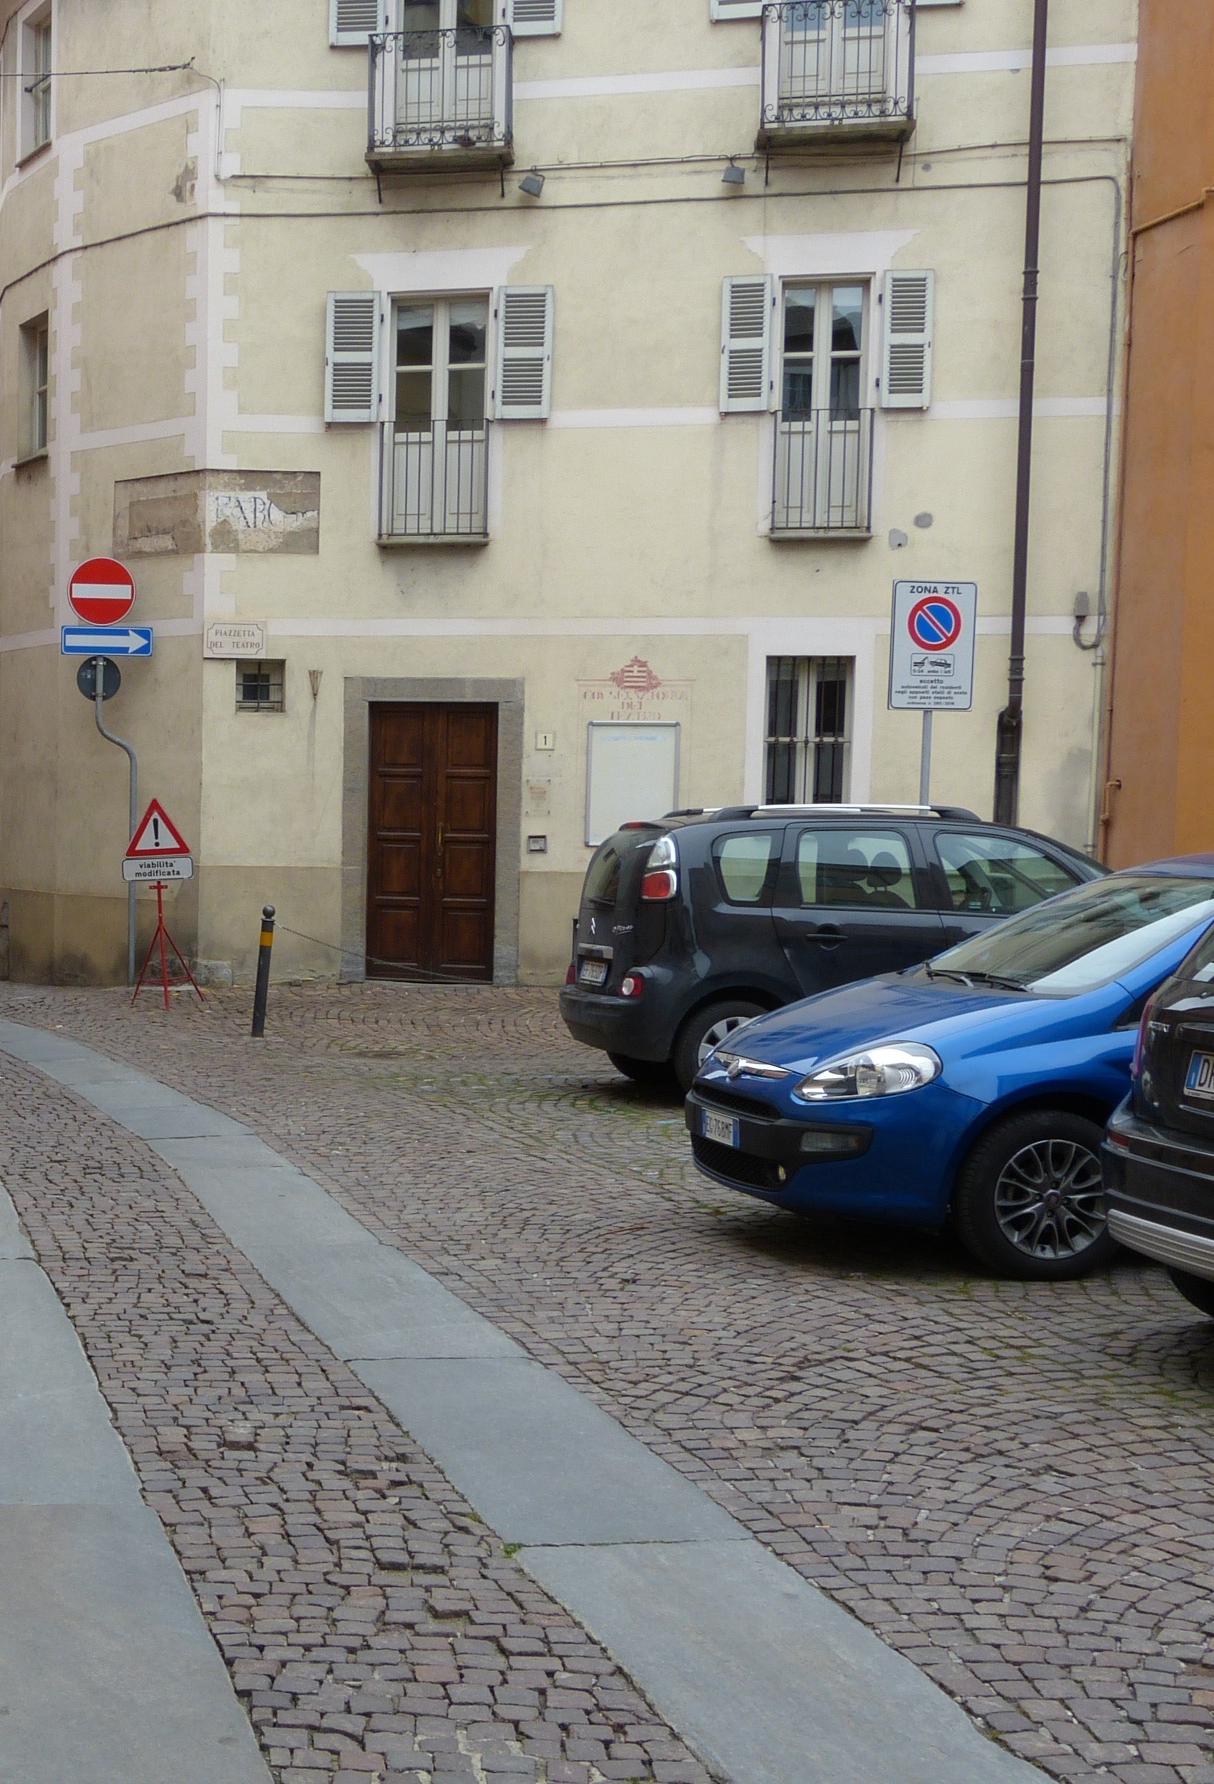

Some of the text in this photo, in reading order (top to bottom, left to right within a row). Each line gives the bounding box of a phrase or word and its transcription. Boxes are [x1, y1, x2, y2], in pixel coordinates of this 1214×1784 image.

[909, 585, 962, 595] ZONA ZTL
[214, 629, 255, 637] PIAZZETTA
[231, 641, 261, 649] TEATRO
[543, 735, 547, 746] 1
[138, 860, 176, 869] viabilita'
[134, 869, 181, 878] modificata
